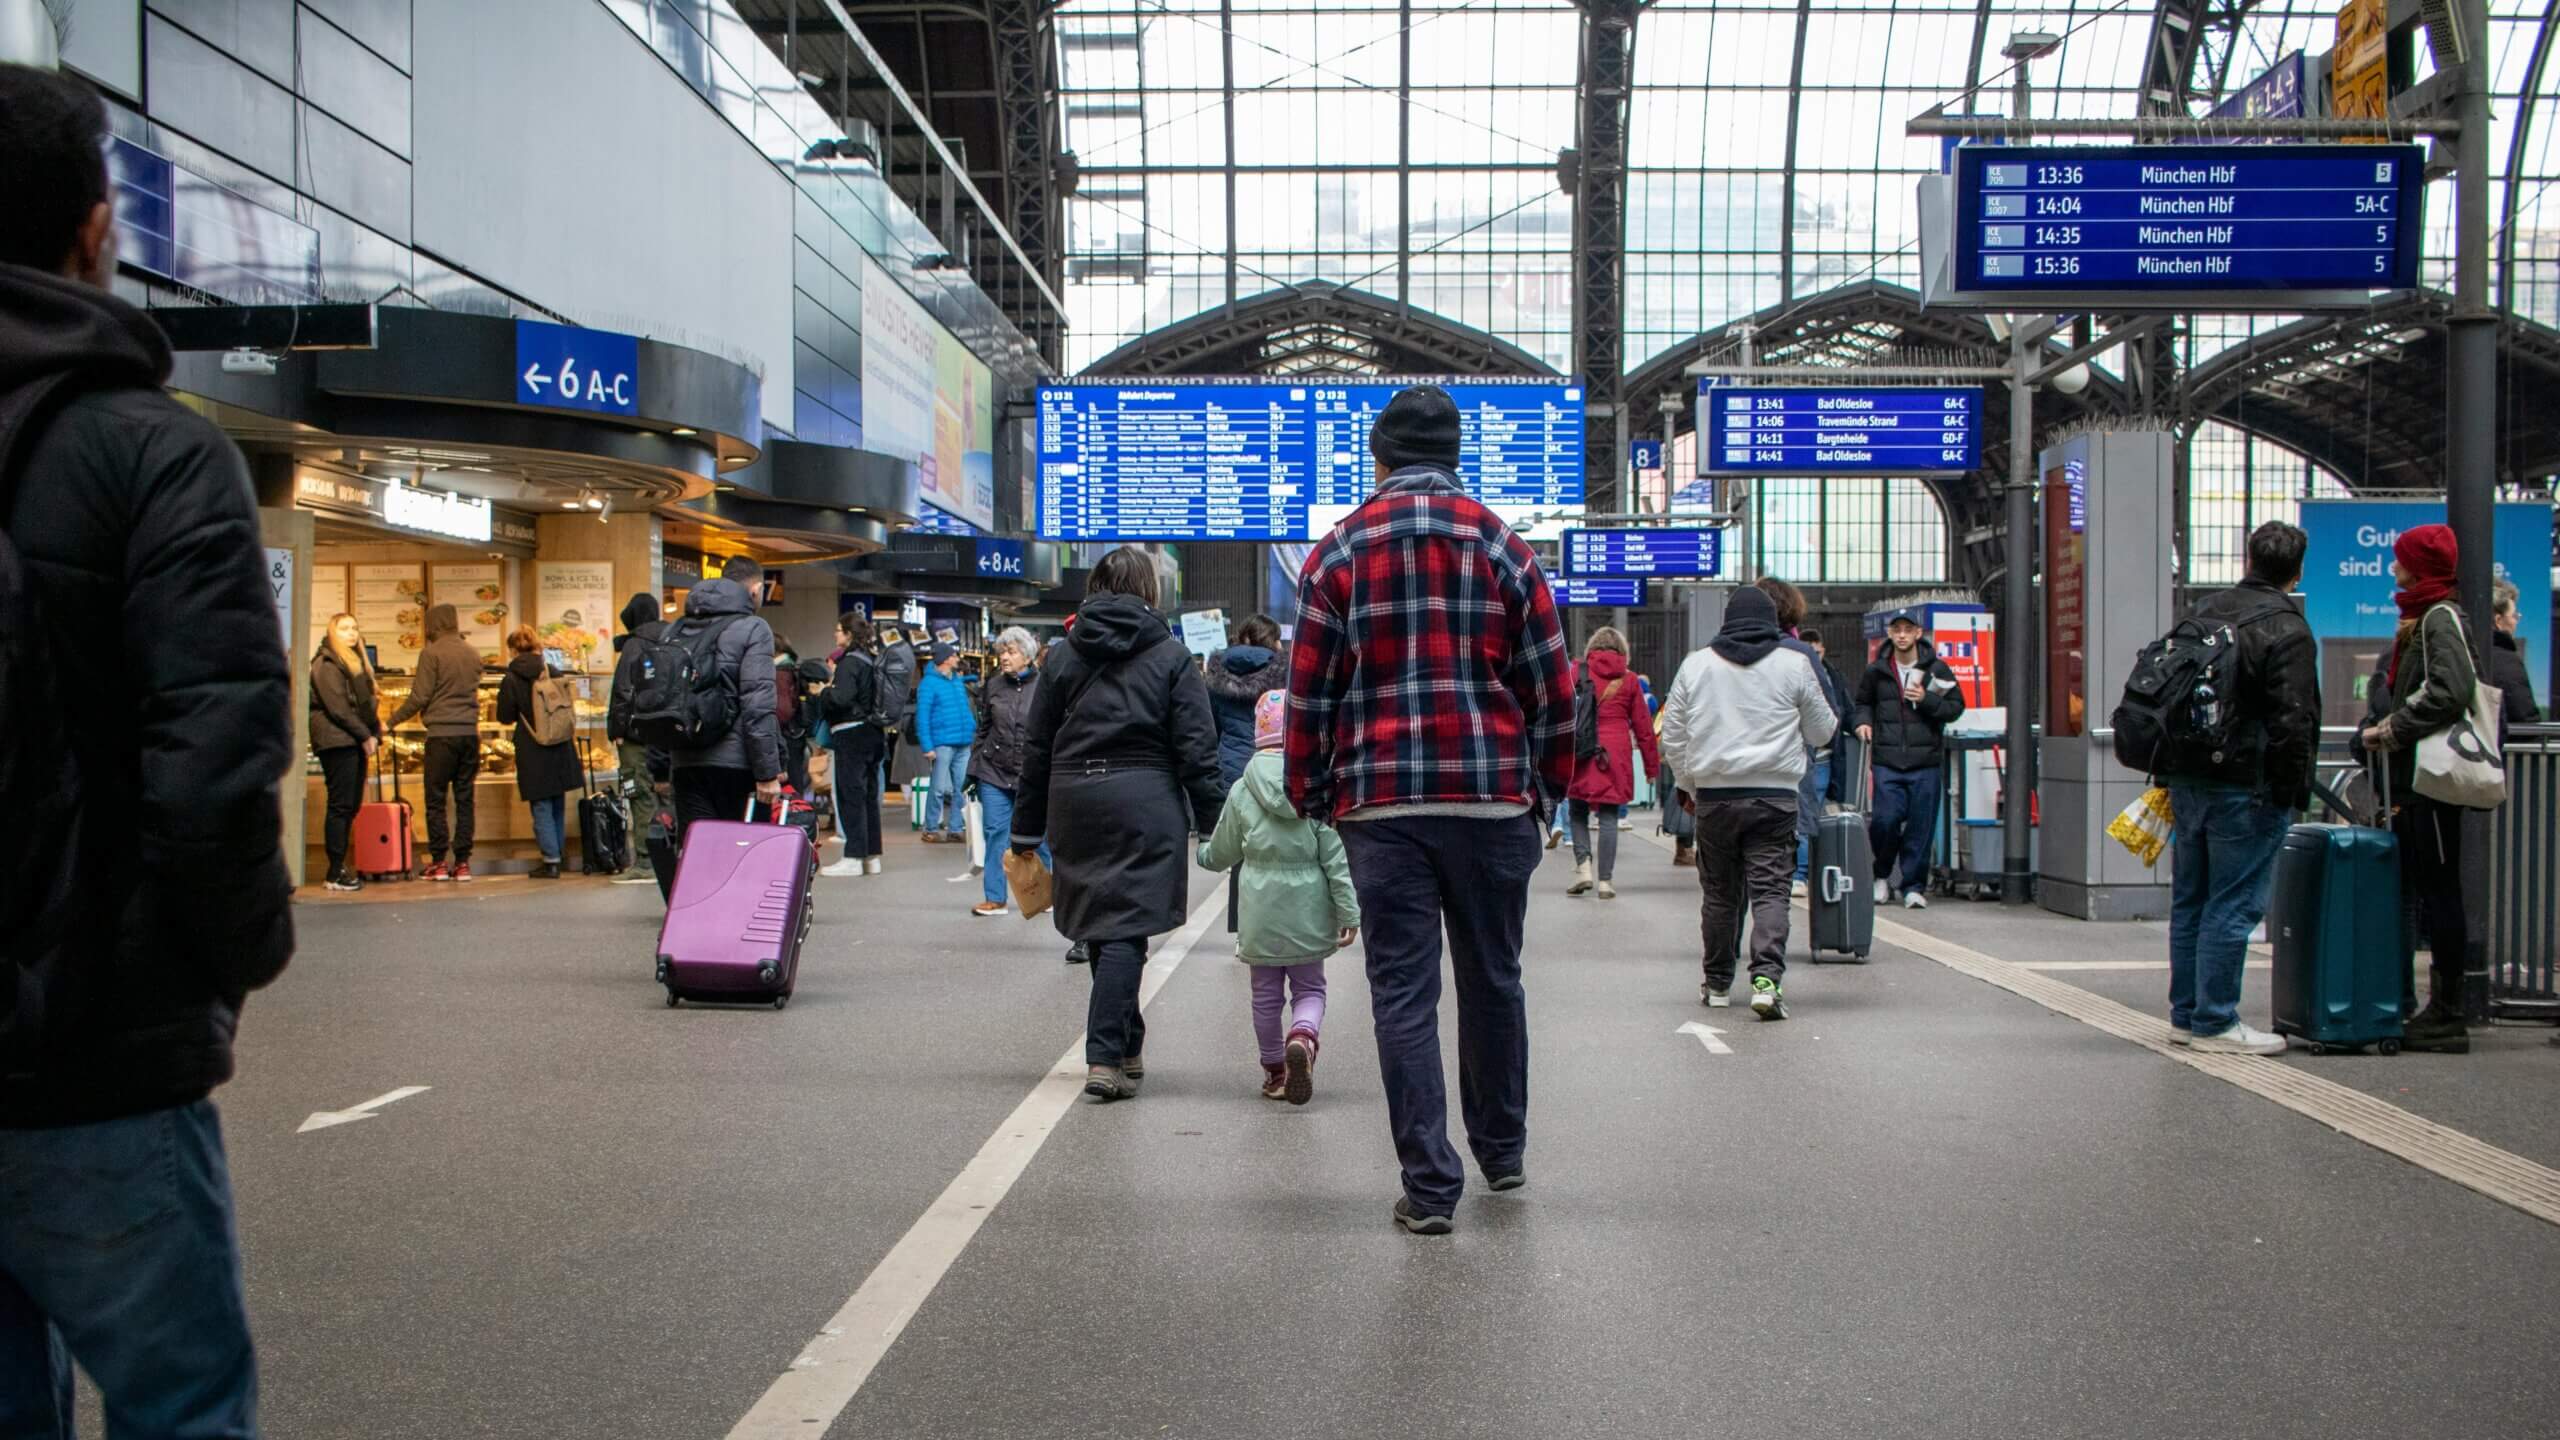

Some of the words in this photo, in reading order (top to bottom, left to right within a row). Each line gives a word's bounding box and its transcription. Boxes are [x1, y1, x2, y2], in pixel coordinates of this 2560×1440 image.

[1989, 167, 2001, 175] ICE
[2038, 167, 2083, 184] 13:36
[2141, 166, 2206, 184] München
[2210, 166, 2237, 184] Hbf
[2380, 165, 2388, 178] 5
[1988, 197, 2000, 206] ICE
[2037, 197, 2082, 214] 14:04
[2140, 196, 2205, 214] München
[2208, 196, 2235, 214] Hbf
[2355, 195, 2389, 213] 5A-C
[1988, 206, 2008, 215] 1007
[1987, 227, 1999, 235] ICE
[2036, 227, 2080, 244] 14:35
[2139, 226, 2203, 244] München
[2207, 226, 2233, 244] Hbf
[2376, 226, 2387, 242] 5
[1986, 257, 1998, 265] ICE
[2034, 257, 2080, 274] 15:36
[2138, 256, 2201, 274] München
[2206, 256, 2232, 274] Hbf
[2375, 256, 2385, 272] 5
[559, 358, 579, 400] 6
[588, 369, 630, 406] A-C
[1048, 375, 1205, 386] Willkommen
[1213, 376, 1250, 386] am
[1455, 375, 1572, 387] Hamburg
[1757, 398, 1784, 410] 13:41
[1817, 397, 1834, 410] Bad
[1836, 397, 1873, 410] Oldesloe
[1944, 398, 1965, 409] 6A-C
[1756, 416, 1784, 427] 14:06
[1817, 415, 1868, 427] Travemünde
[1869, 415, 1898, 427] Strand
[1943, 415, 1965, 426] 6A-C
[1756, 433, 1783, 444] 14:11
[1816, 432, 1869, 446] Bargteheide
[1942, 432, 1964, 444] 6D-F
[1636, 449, 1648, 468] 8
[1756, 450, 1783, 462] 14:41
[1816, 449, 1832, 461] Bad
[1834, 449, 1872, 461] Oldesloe
[1942, 450, 1963, 461] 6A-C
[992, 552, 1001, 572] 8
[1003, 557, 1021, 573] A-C
[2339, 554, 2382, 577] sind
[765, 580, 777, 601] 7
[2356, 603, 2377, 614] Hier
